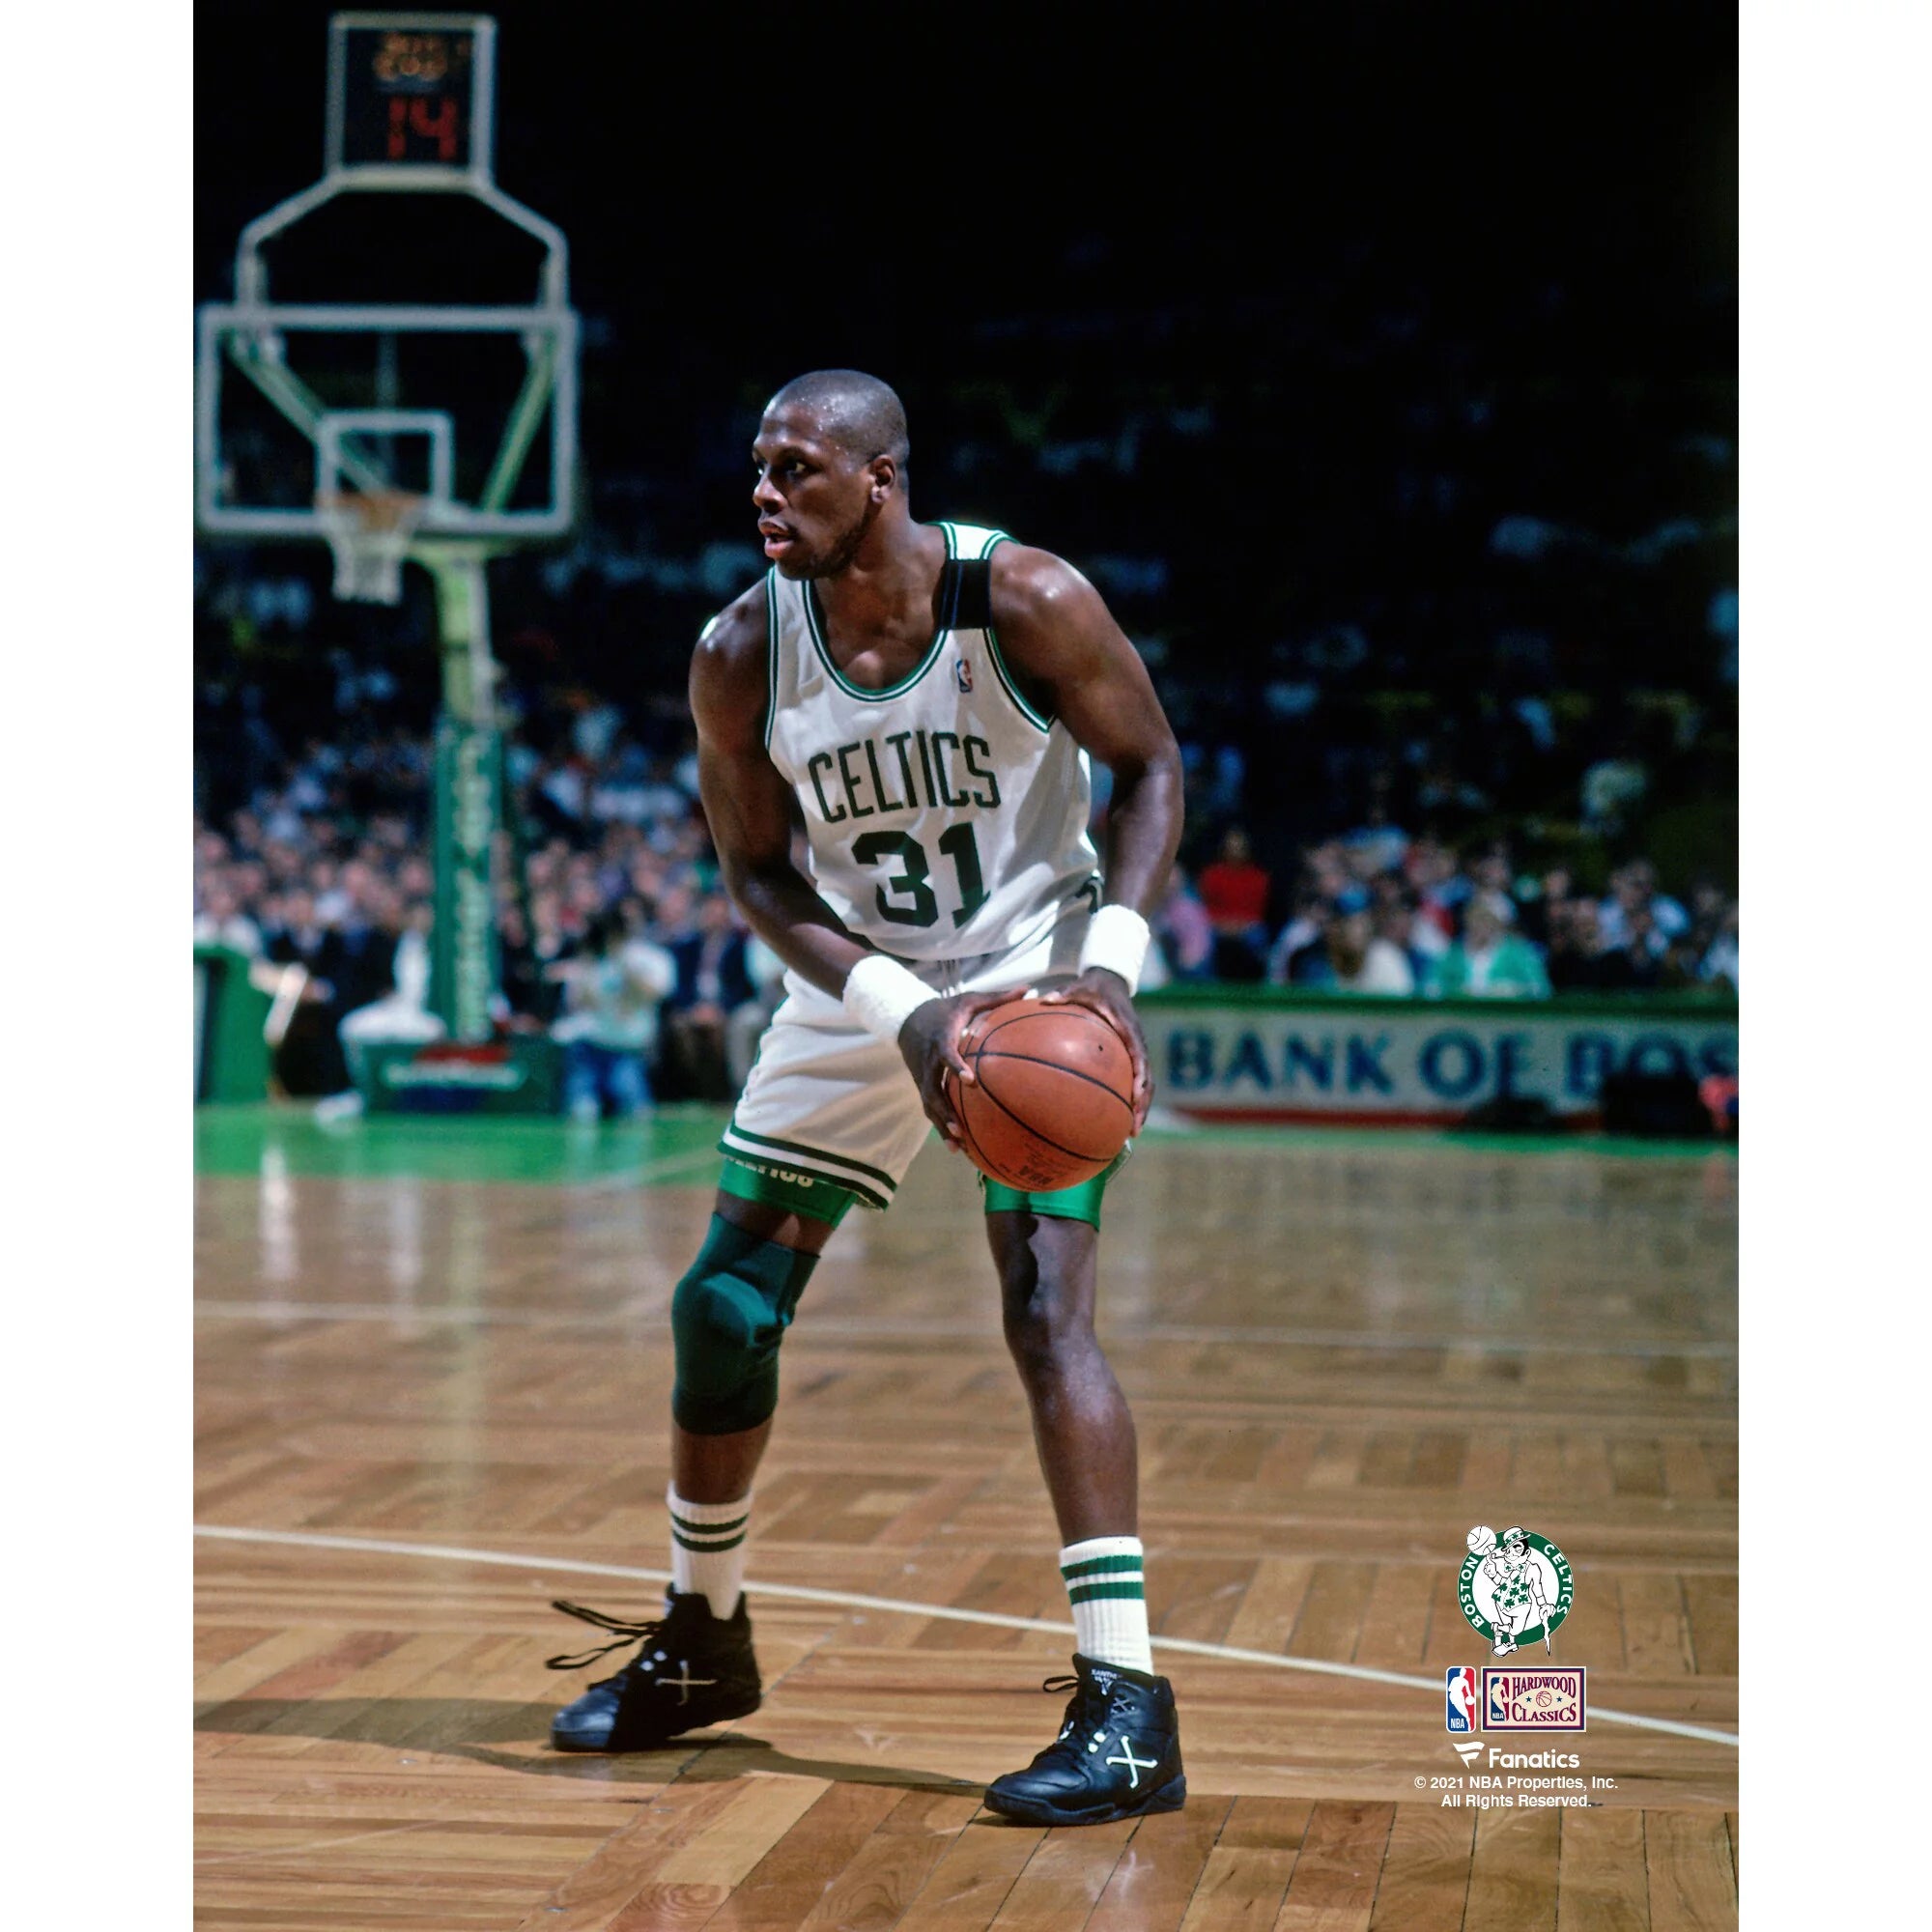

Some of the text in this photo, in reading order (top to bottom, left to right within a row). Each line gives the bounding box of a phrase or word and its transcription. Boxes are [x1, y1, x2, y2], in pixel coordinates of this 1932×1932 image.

[388, 97, 457, 160] 14
[808, 729, 1001, 823] CELTICS
[851, 822, 991, 928] 31
[1166, 1029, 1394, 1095] BANK
